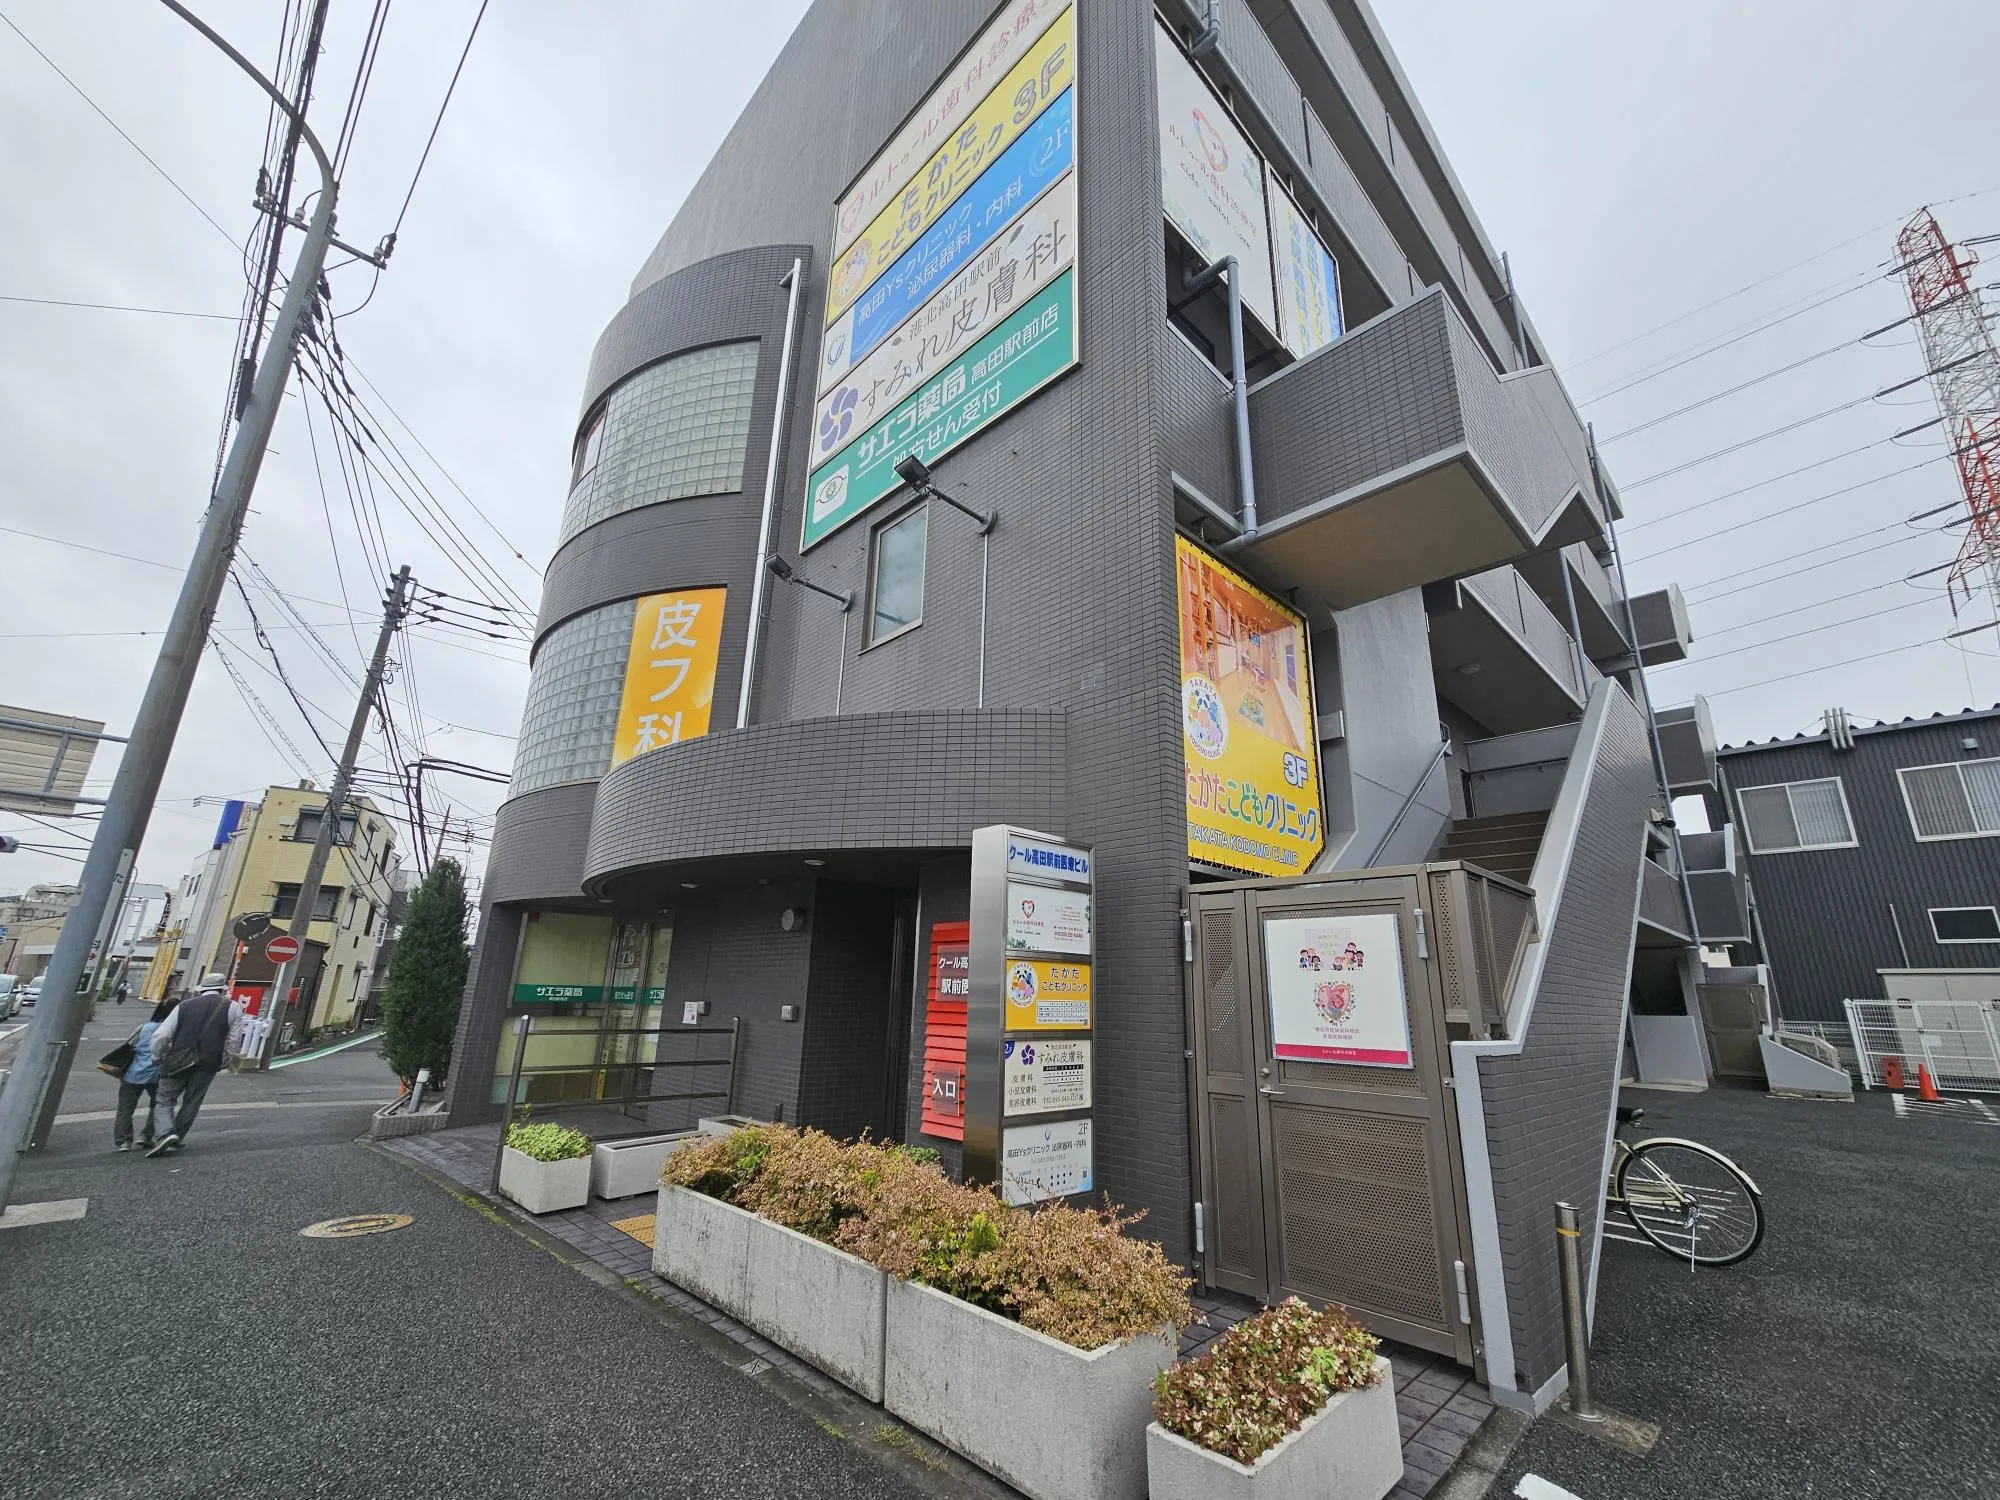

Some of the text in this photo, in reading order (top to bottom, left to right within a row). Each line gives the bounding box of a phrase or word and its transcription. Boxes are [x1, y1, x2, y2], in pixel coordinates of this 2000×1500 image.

[869, 0, 1049, 202] ルトゥール歯科診療
[1013, 42, 1067, 125] 3F
[1040, 119, 1071, 165] 2F
[900, 122, 979, 218] たかた
[876, 122, 1004, 265] こどもクリニック
[908, 176, 1023, 300] 泌尿器科・内科
[909, 246, 1001, 341] 港北高田駅前
[862, 218, 1067, 420] すみれ皮膚科
[857, 302, 1060, 468] サエラ薬局 高田駅前店
[633, 599, 701, 753] 皮フ科
[1190, 678, 1217, 699] TAKATA
[1283, 751, 1308, 789] 3F
[1184, 761, 1317, 843] たかたこどもクリニック
[1009, 844, 1088, 873] クール高田駅前医療ビル
[1187, 822, 1299, 867] TAKATA KODOMO CLINIC
[536, 986, 583, 997] サエラ薬局
[1041, 981, 1088, 993] こどもクリニック
[1051, 967, 1080, 979] たかた
[1038, 1050, 1084, 1064] すみれ皮膚科
[932, 1078, 956, 1098] 入口
[1078, 1122, 1089, 1135] 2F
